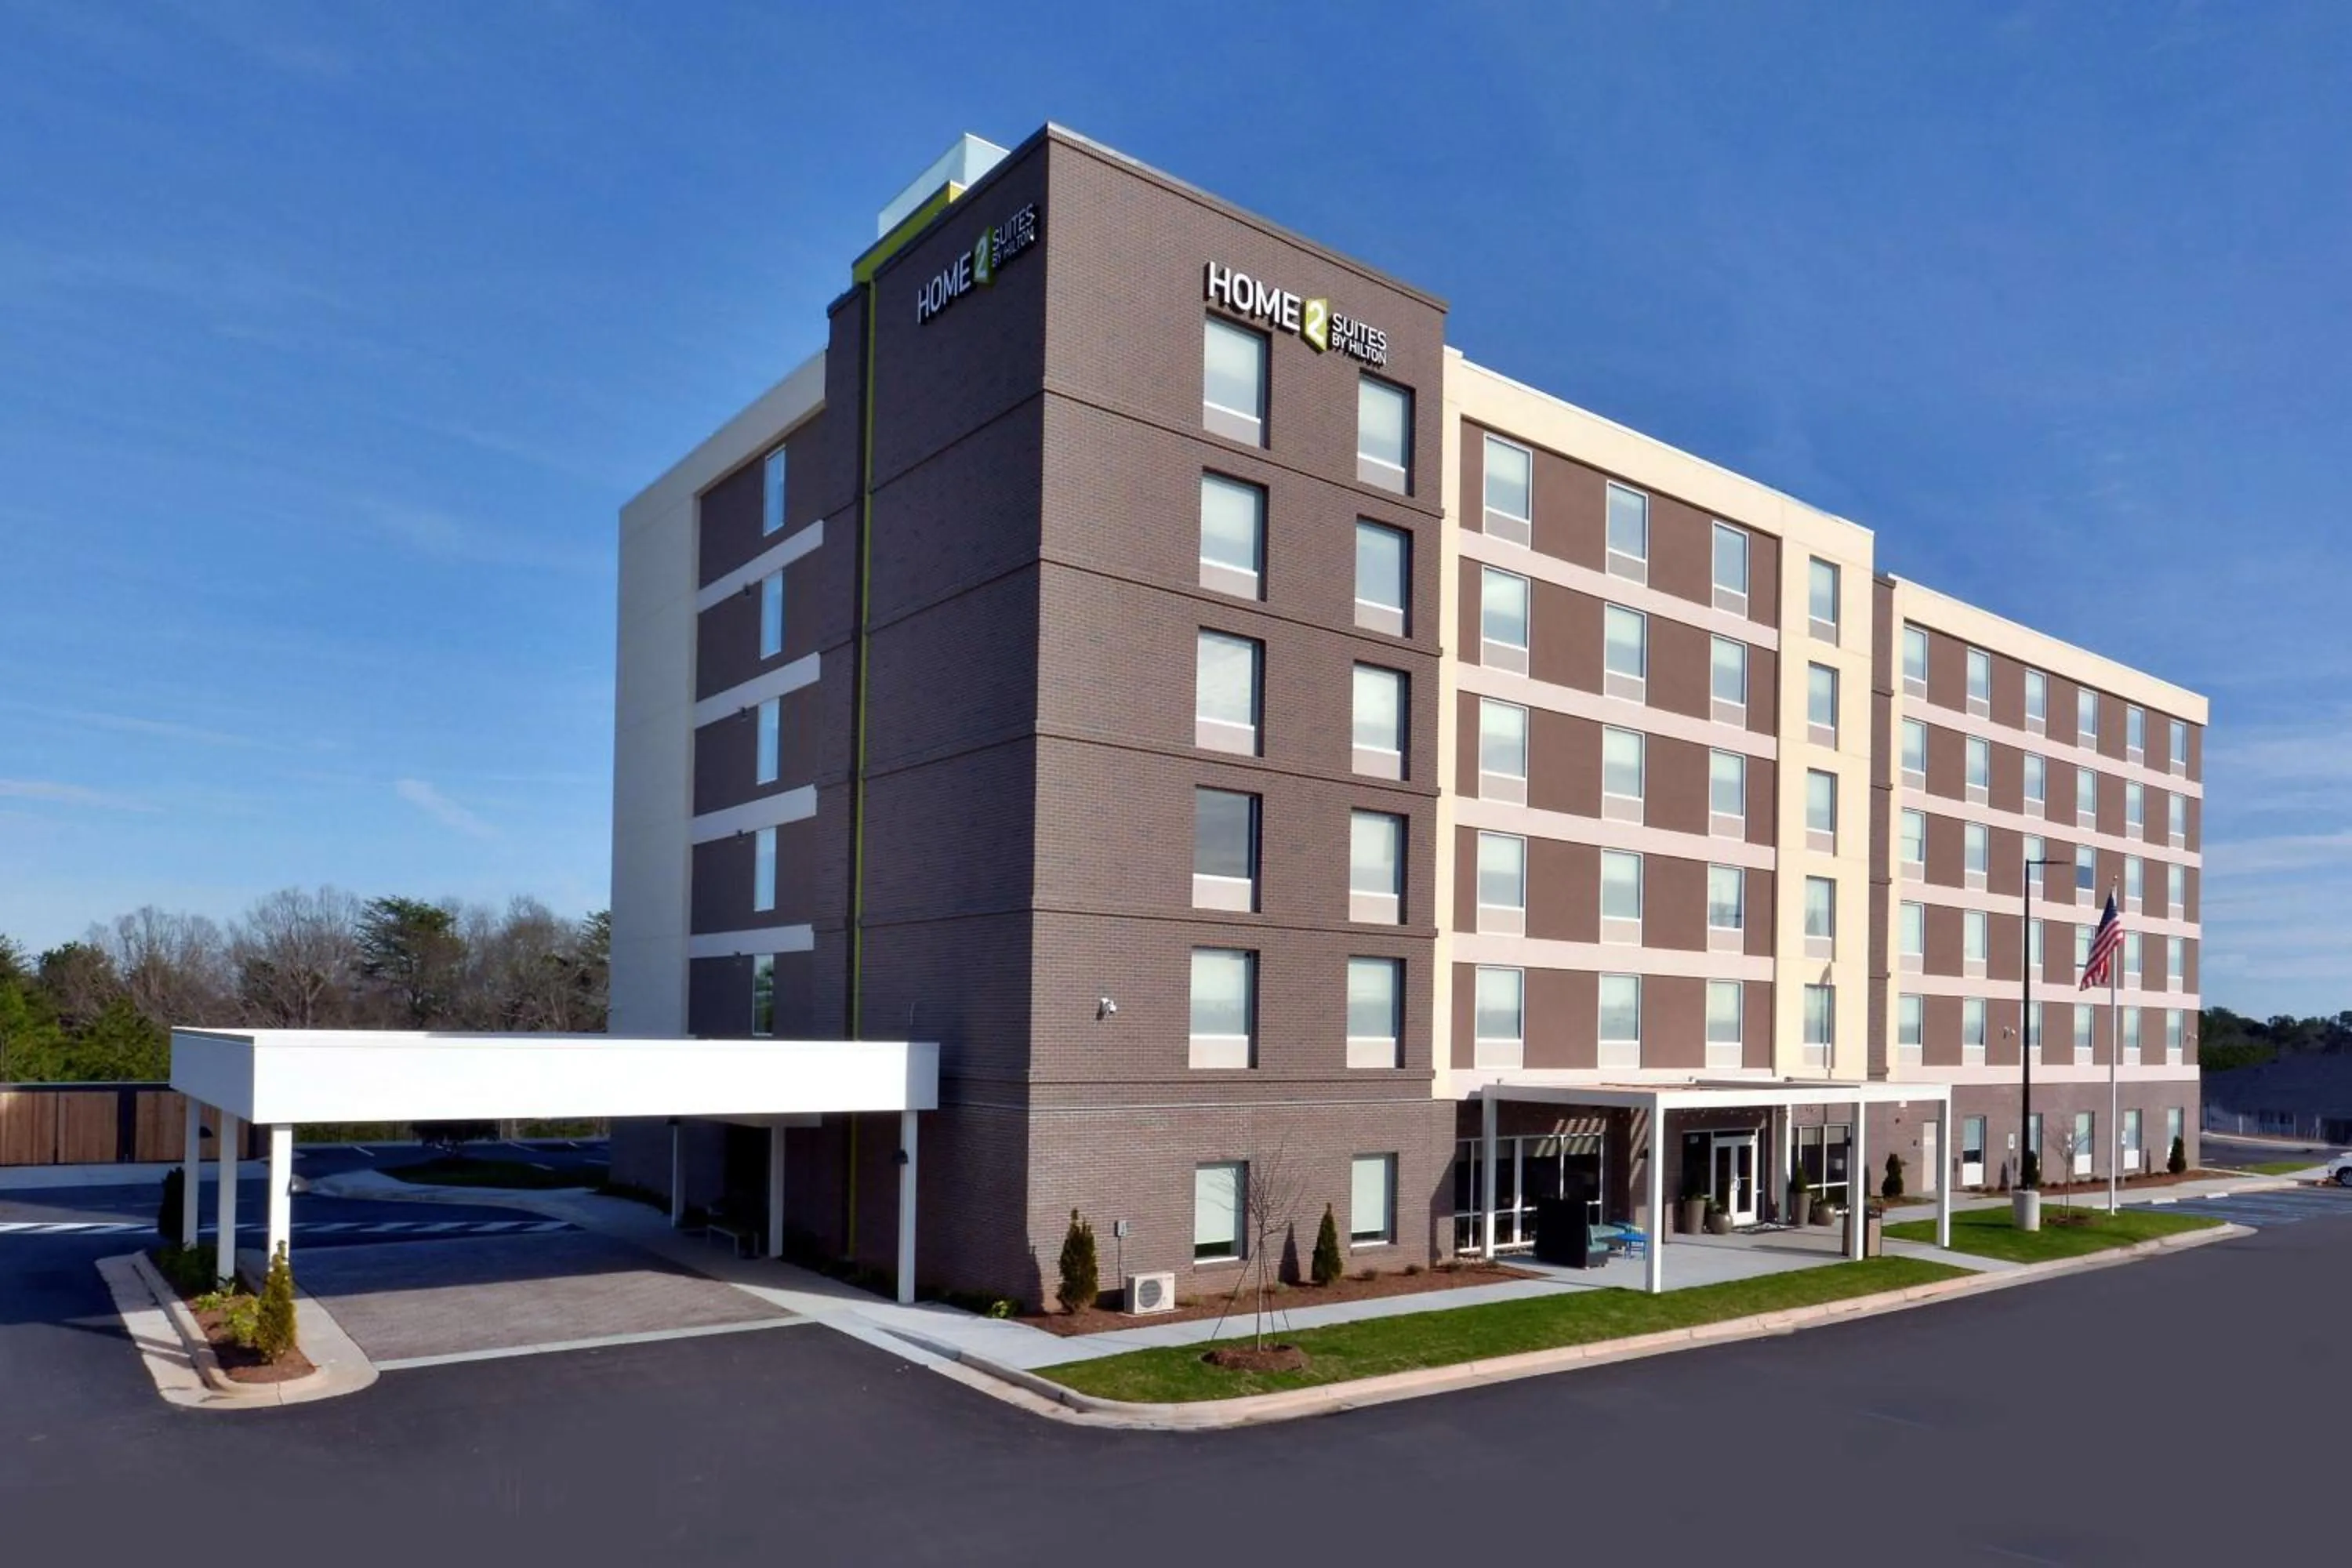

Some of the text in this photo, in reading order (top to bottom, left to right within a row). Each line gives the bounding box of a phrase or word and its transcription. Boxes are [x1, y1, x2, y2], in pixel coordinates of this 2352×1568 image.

[916, 203, 1036, 324] HOME 2 SUITES
[1208, 260, 1387, 350] HOME 2 SUITES
[1332, 332, 1387, 366] BY HILTON
